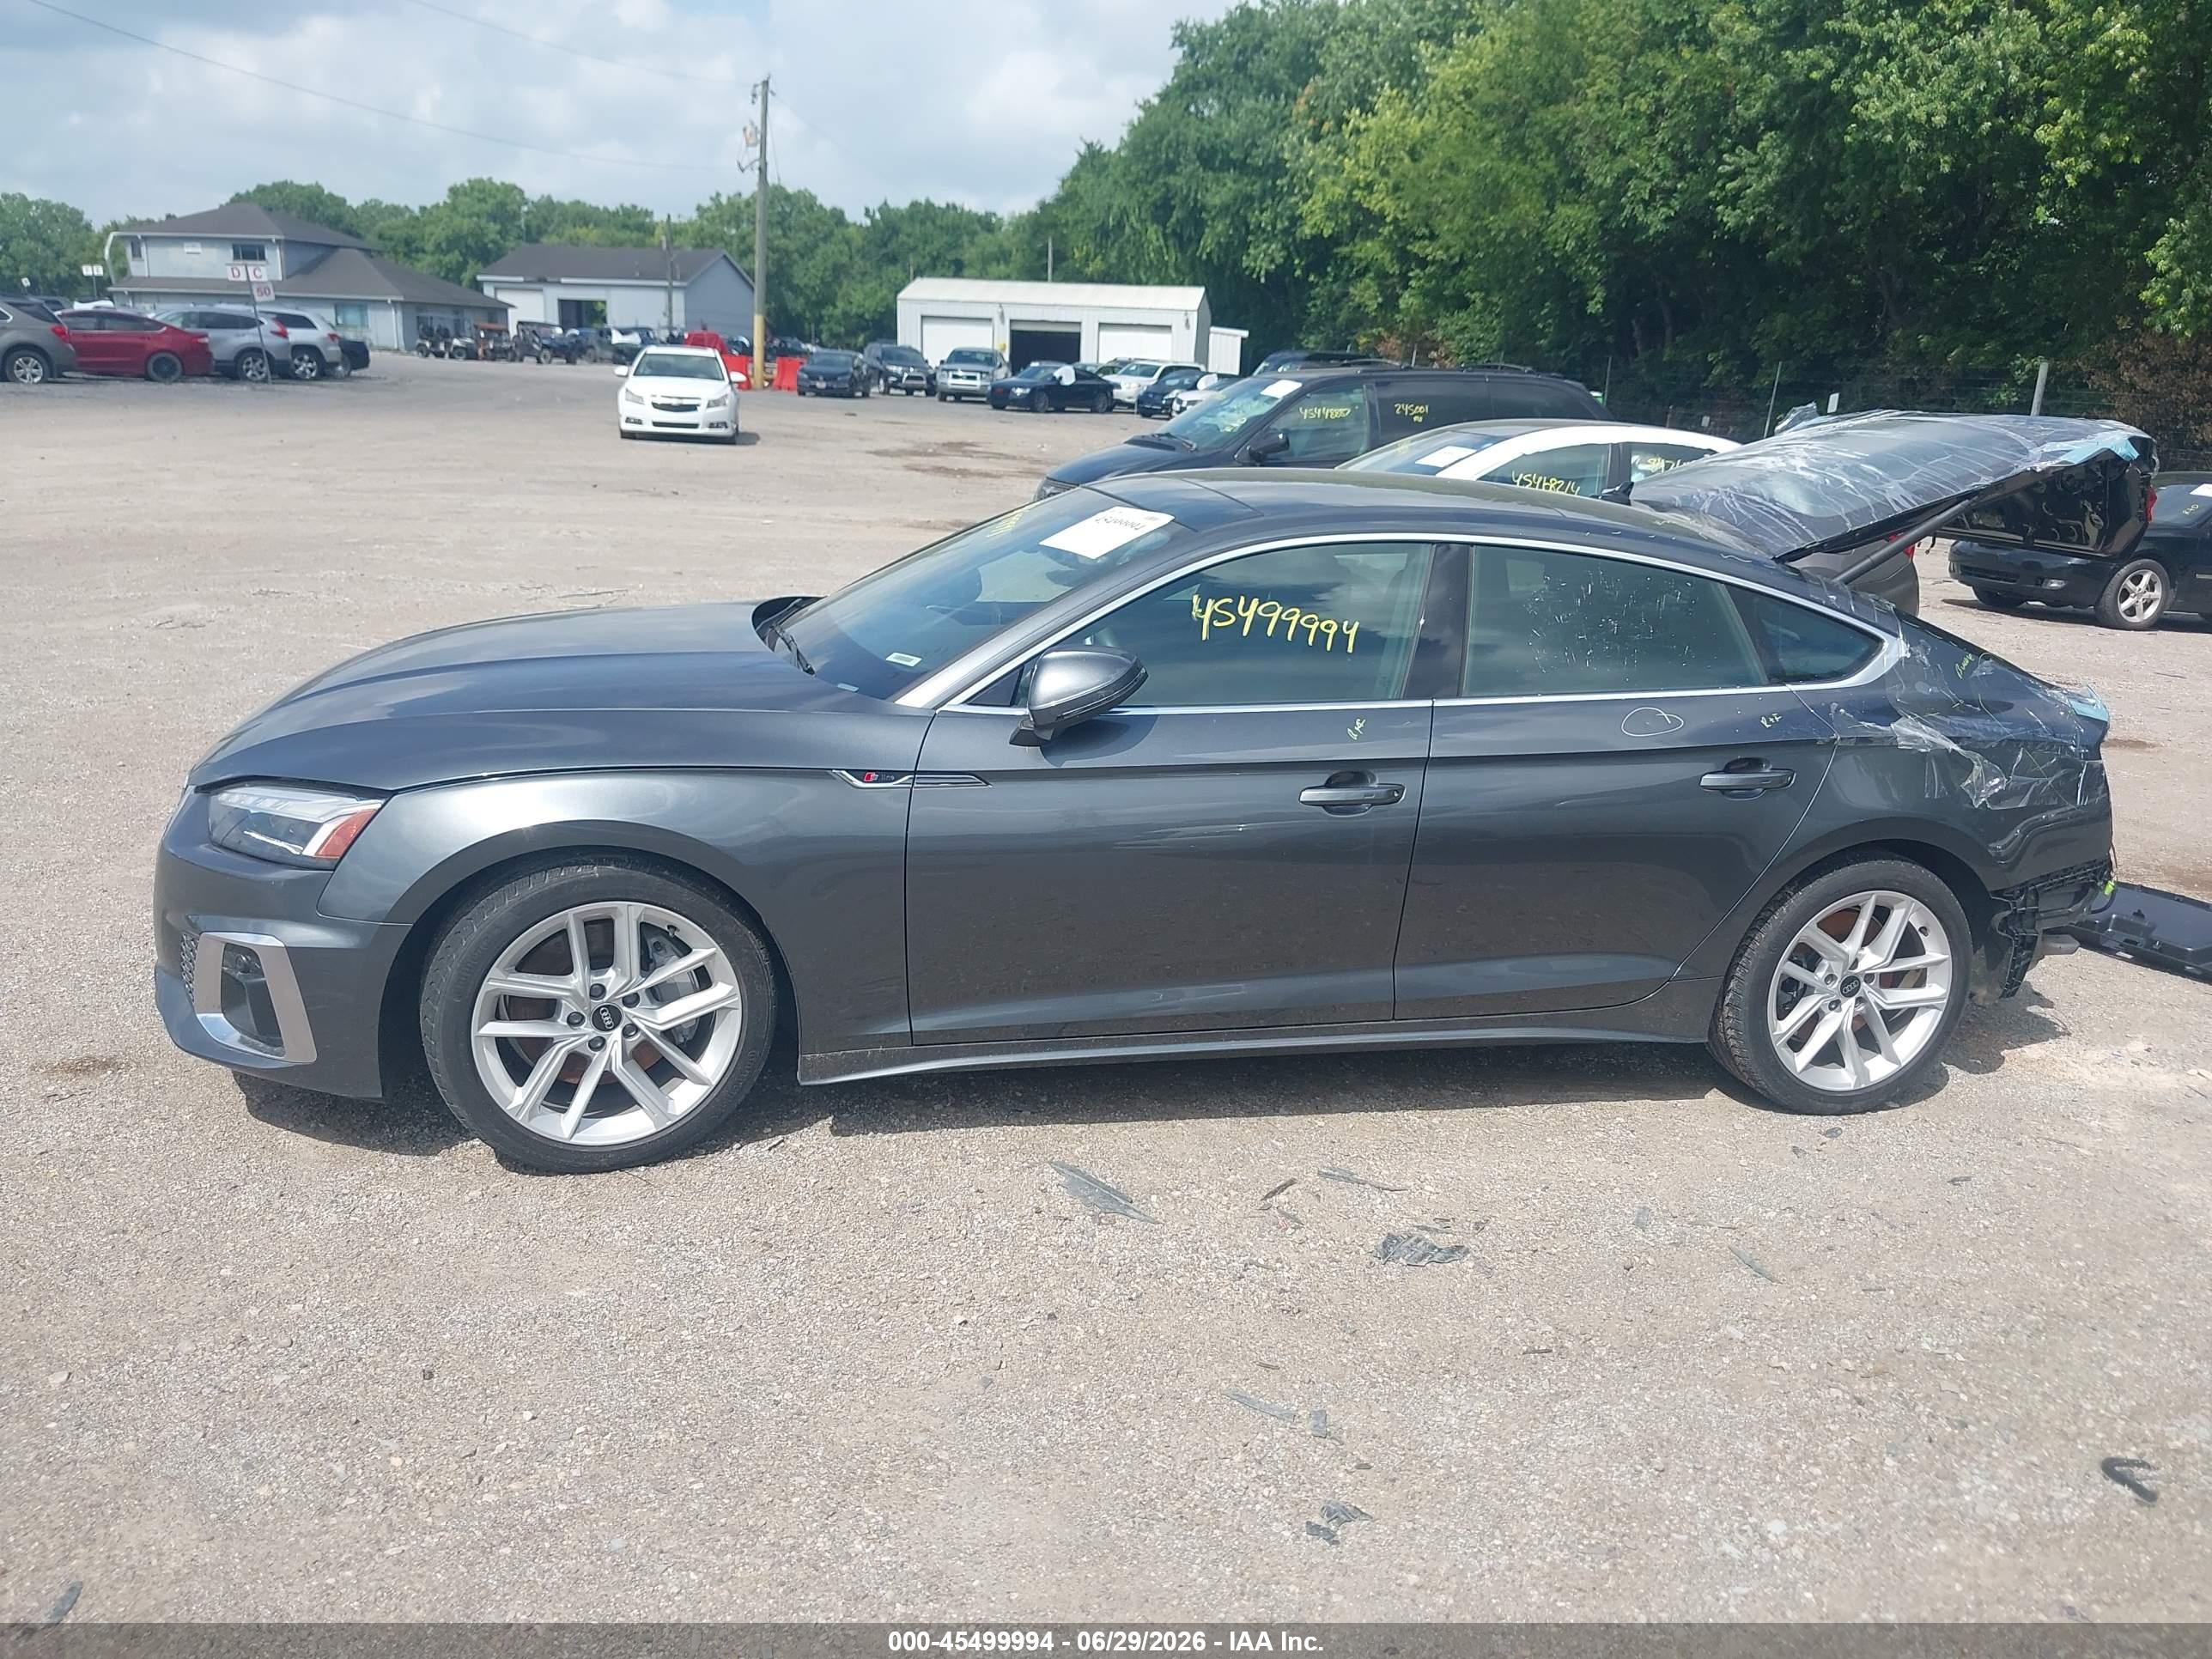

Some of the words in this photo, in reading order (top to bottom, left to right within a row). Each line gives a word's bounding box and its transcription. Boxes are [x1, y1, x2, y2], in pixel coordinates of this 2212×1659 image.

[230, 266, 240, 278] D
[253, 267, 262, 279] C
[257, 287, 271, 297] 50
[1191, 593, 1360, 654] 45499994
